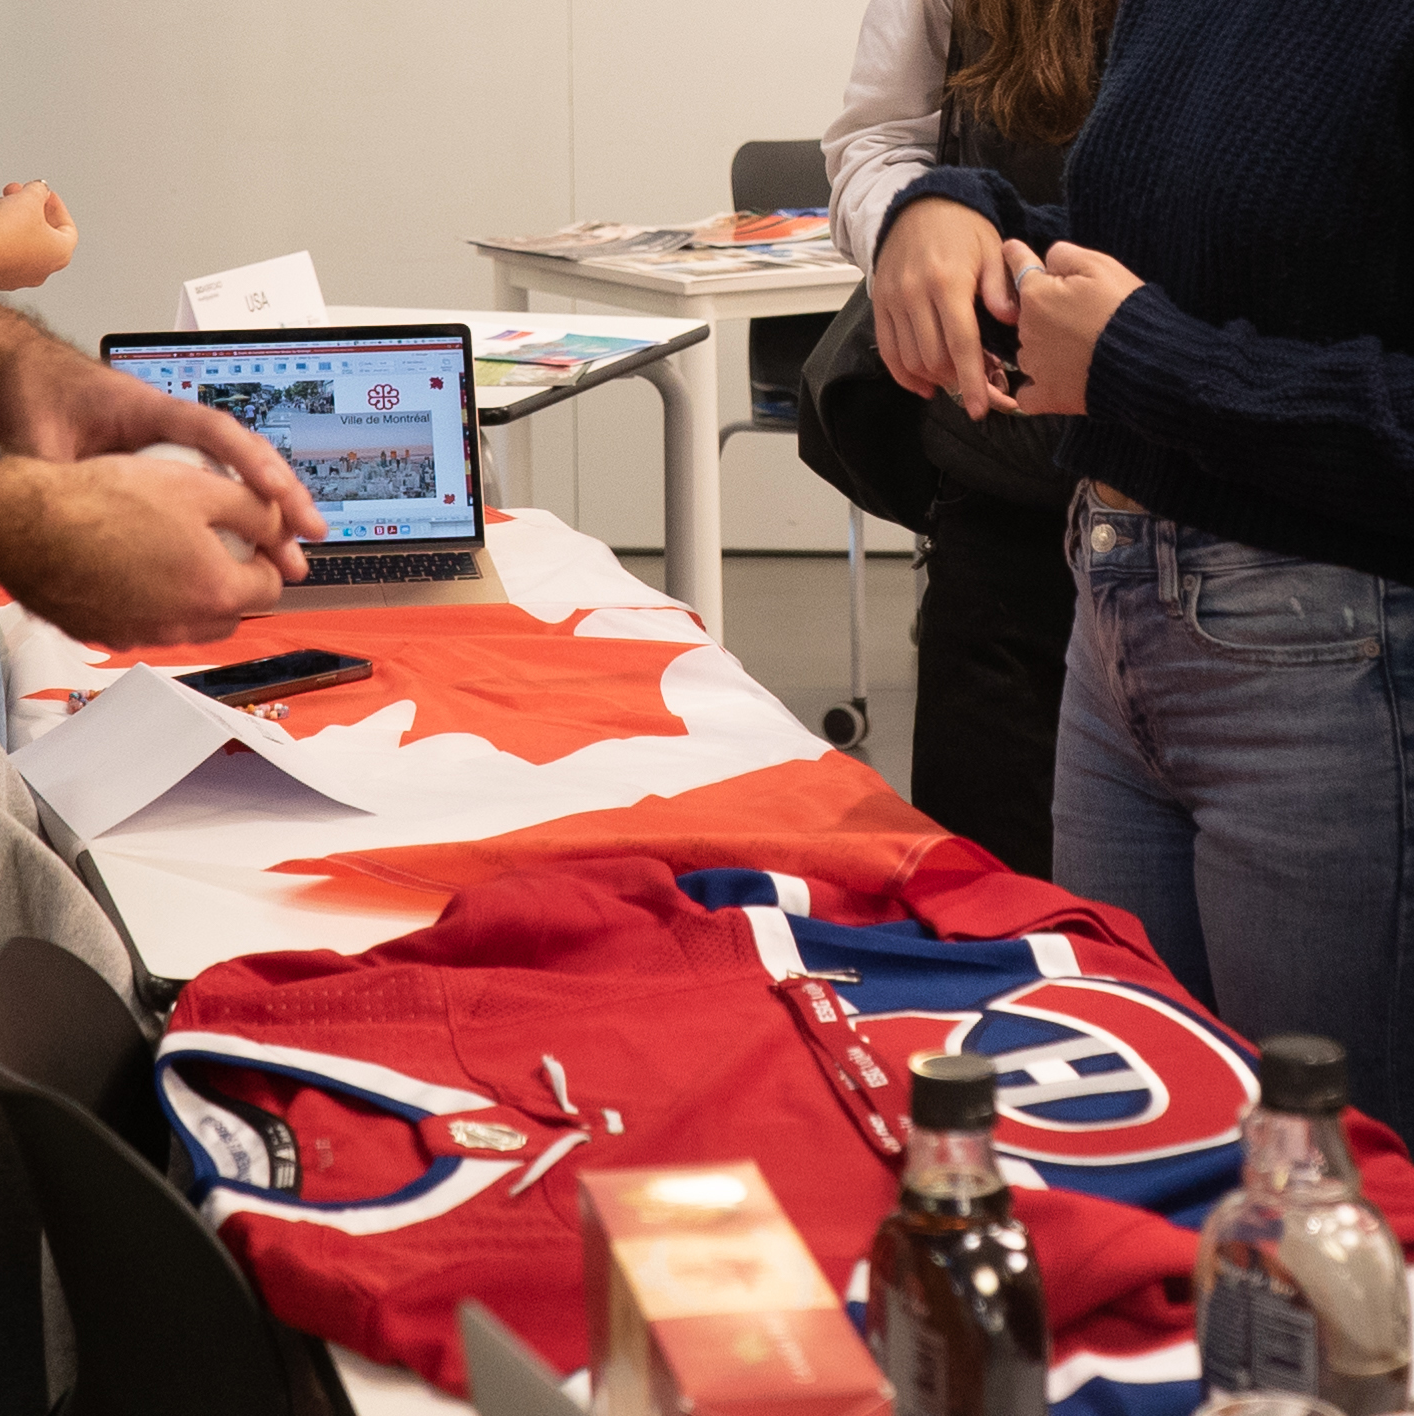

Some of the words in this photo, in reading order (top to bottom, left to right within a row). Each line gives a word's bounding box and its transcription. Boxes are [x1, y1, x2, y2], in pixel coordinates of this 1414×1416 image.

[245, 291, 271, 313] USA
[340, 415, 363, 425] Ville
[366, 415, 380, 425] de
[383, 413, 431, 425] Montréal
